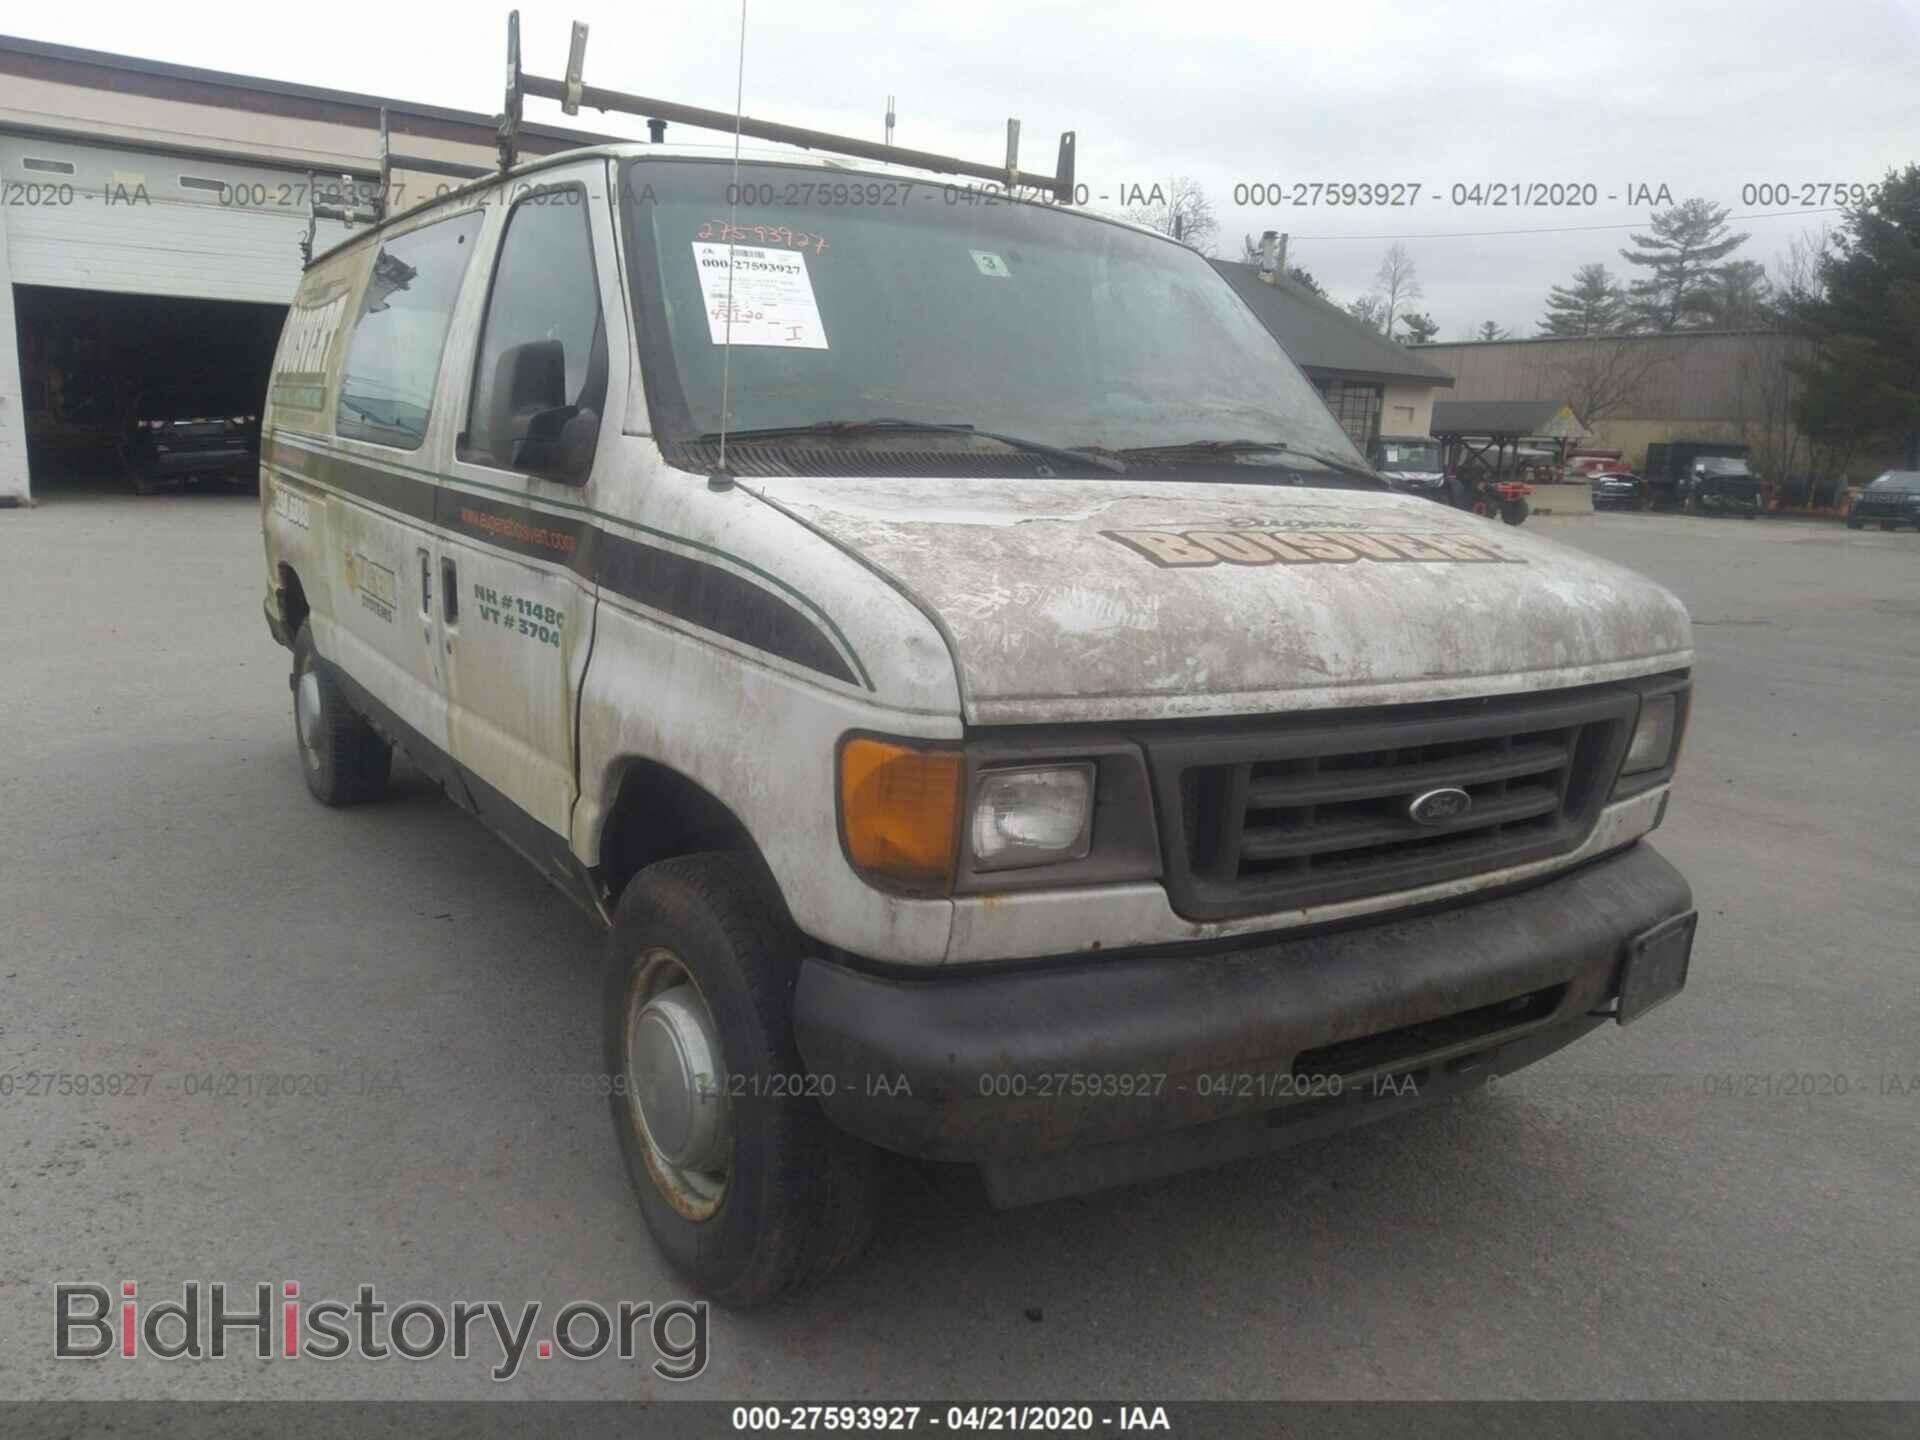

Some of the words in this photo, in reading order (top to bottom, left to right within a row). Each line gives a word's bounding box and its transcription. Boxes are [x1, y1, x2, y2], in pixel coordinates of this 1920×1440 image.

[697, 219, 830, 257] 27593927
[474, 583, 498, 606] NH
[480, 603, 500, 625] VT
